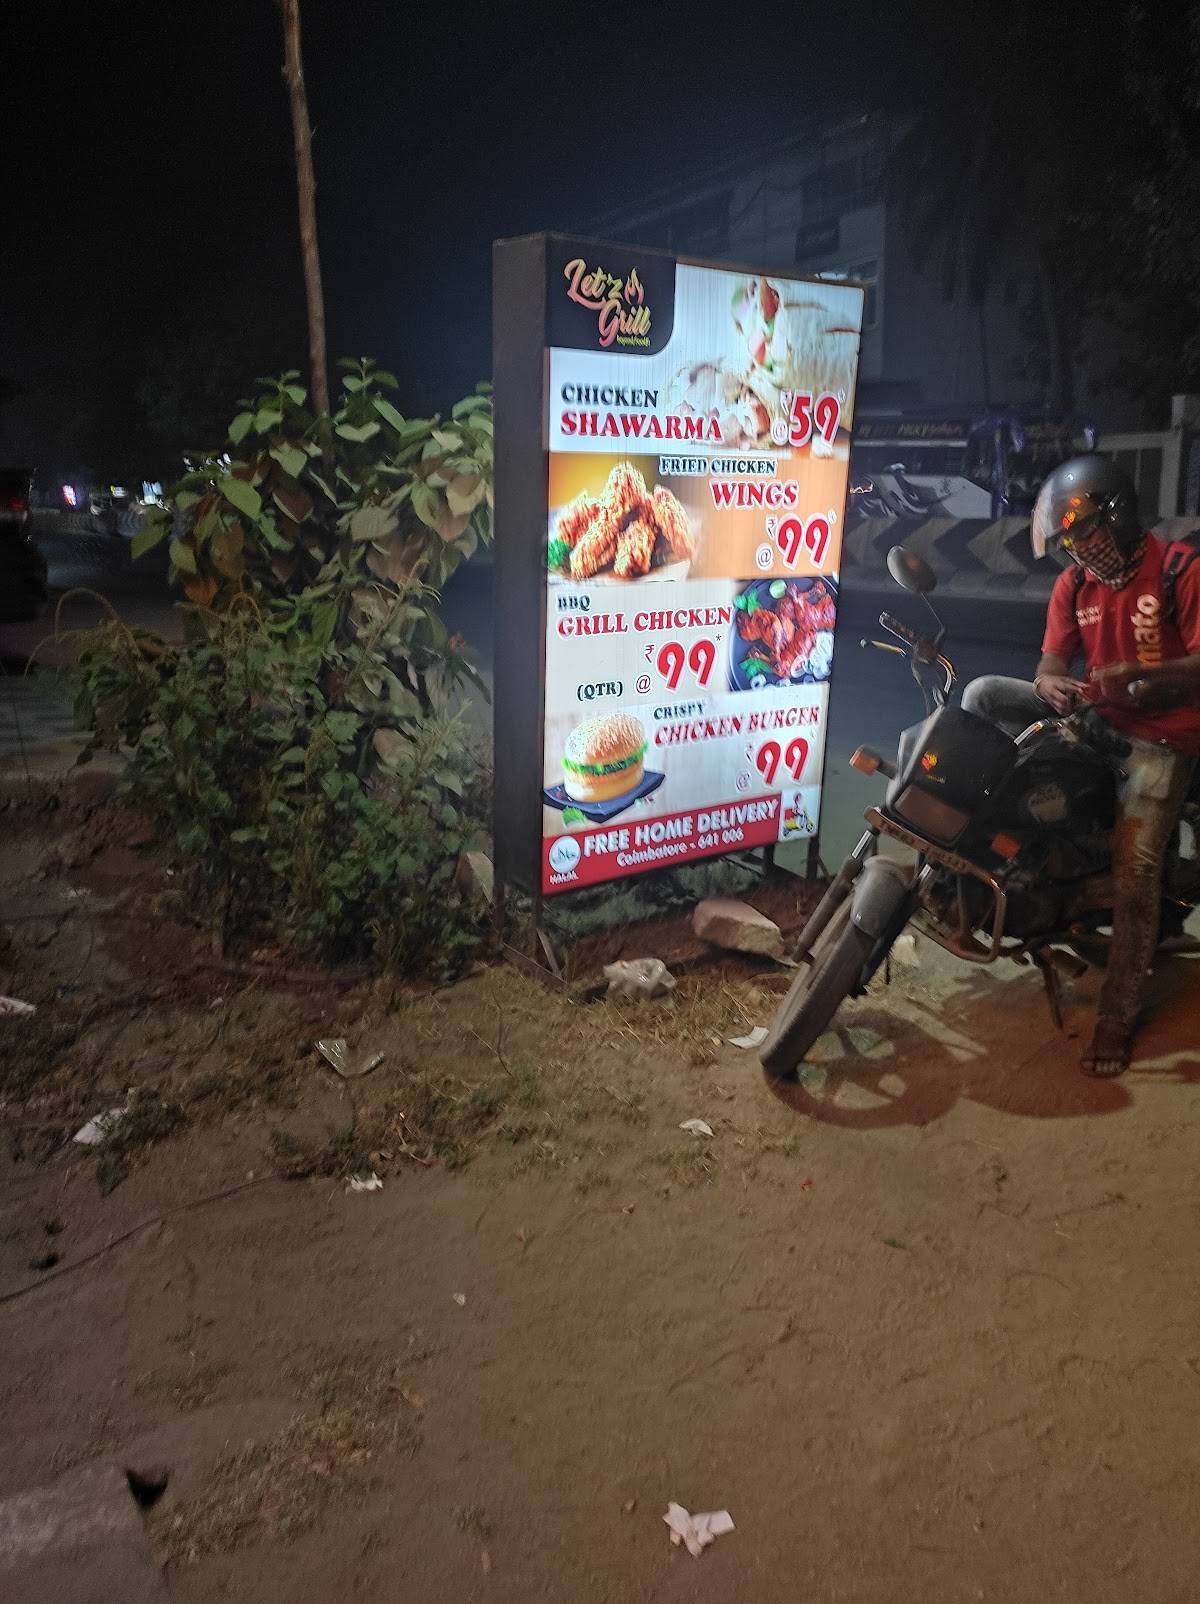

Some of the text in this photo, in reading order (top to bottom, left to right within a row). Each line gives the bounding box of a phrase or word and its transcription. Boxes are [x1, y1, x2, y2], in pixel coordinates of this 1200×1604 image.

[599, 299, 651, 347] Grill
[561, 382, 658, 408] CHICKEN
[561, 410, 724, 442] SHAWARMA
[661, 457, 776, 475] FRIED CHICKEN
[711, 481, 798, 507] WINGS
[557, 595, 591, 611] BBQ
[557, 607, 733, 637] GRILL CHICKEN
[577, 681, 623, 702] (QTR)
[653, 700, 705, 720] CRISPY
[655, 705, 820, 746] CHICKEN BURGER
[584, 828, 630, 857] FREE
[635, 816, 693, 847] HOME
[697, 799, 779, 832] DELIVERY
[617, 840, 688, 867] Coimbatore
[698, 832, 719, 849] 641
[722, 828, 745, 844] 006
